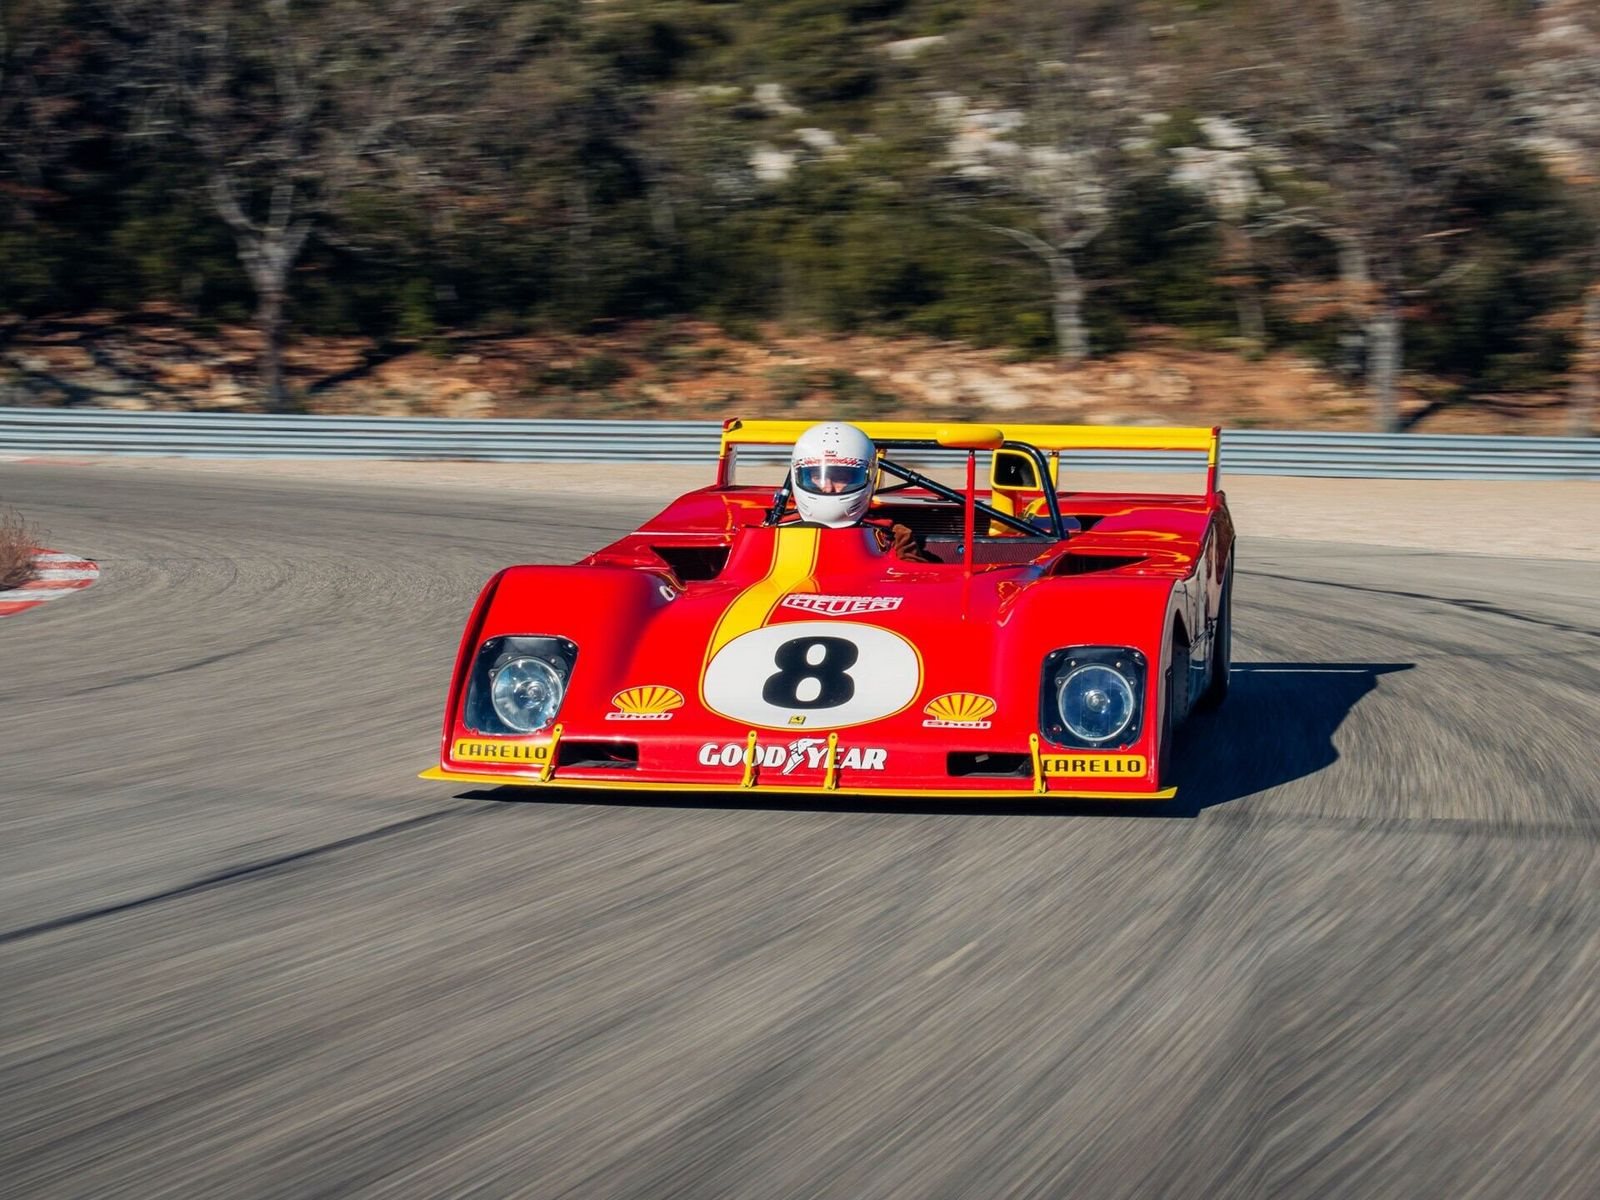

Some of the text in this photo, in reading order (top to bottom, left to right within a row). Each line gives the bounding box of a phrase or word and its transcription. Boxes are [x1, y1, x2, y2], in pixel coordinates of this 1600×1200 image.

[762, 636, 859, 710] 8
[458, 743, 548, 760] CARELLO
[1043, 759, 1141, 773] CARELLO
